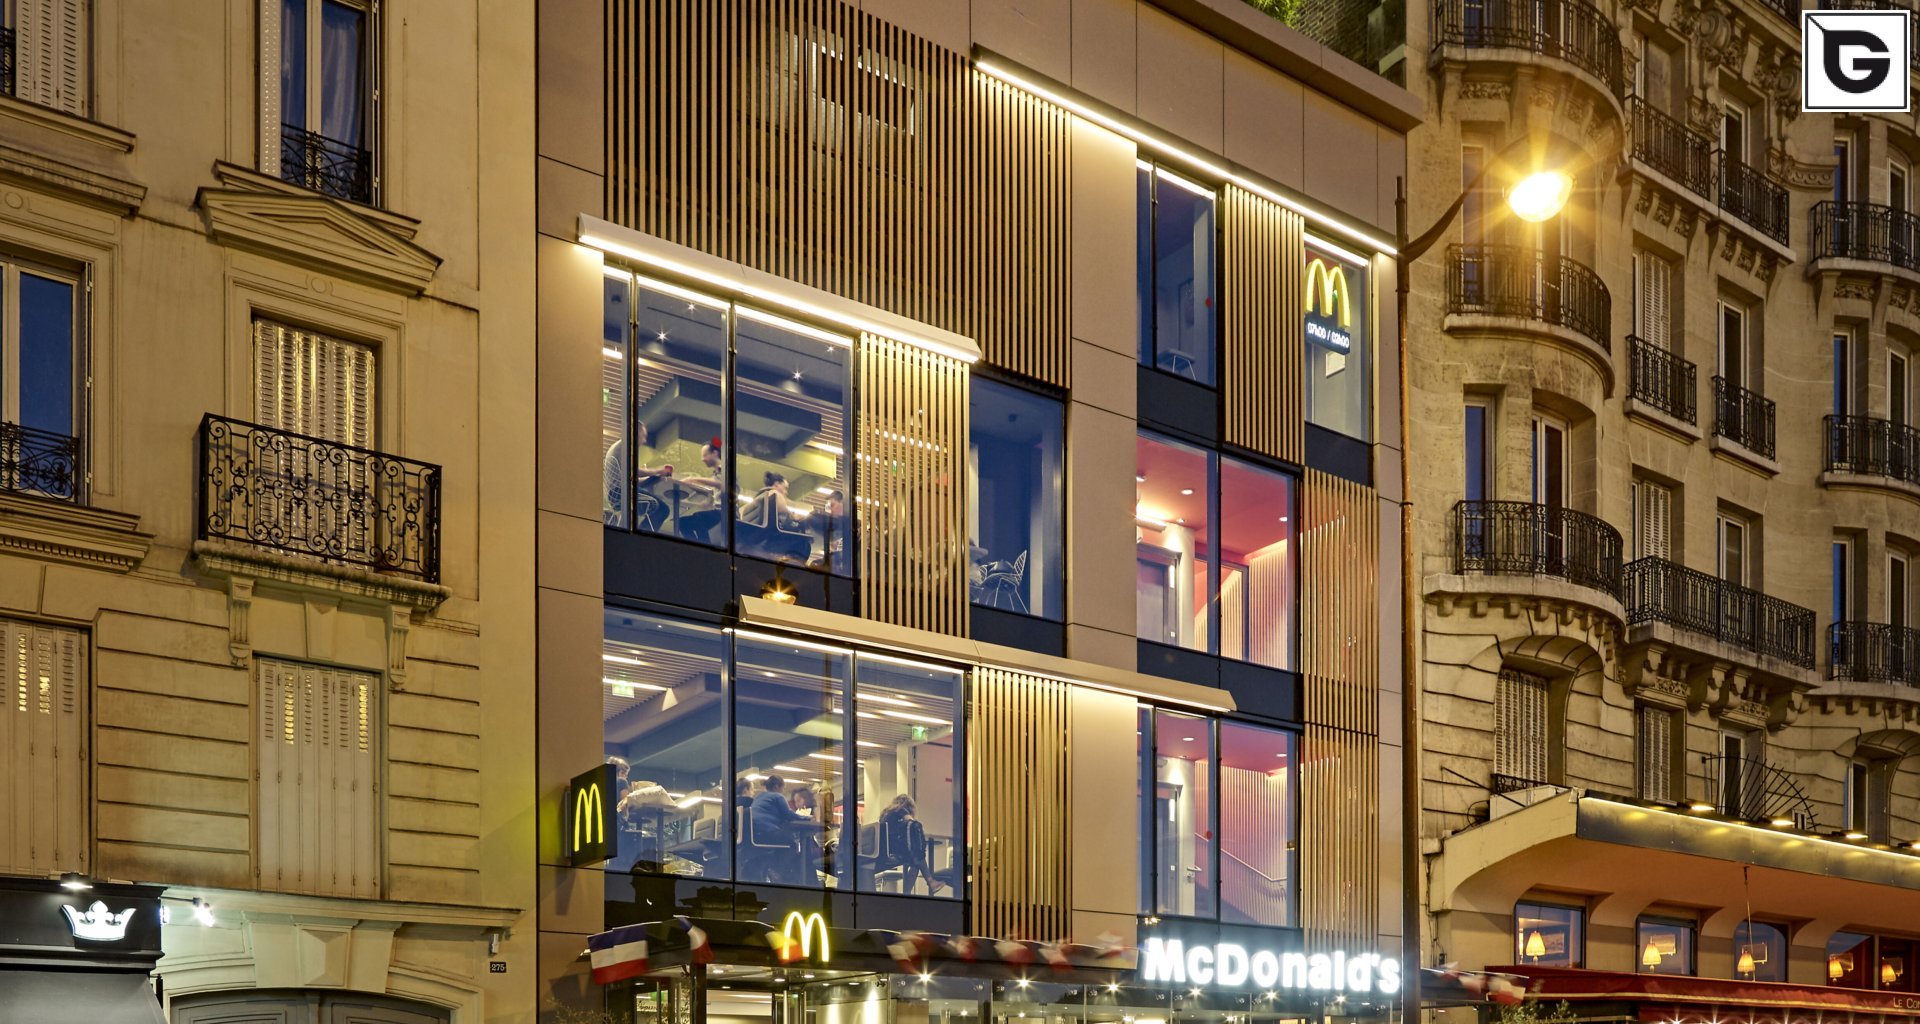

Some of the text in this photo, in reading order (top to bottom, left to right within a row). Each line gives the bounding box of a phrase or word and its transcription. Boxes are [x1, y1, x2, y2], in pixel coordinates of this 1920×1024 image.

[574, 783, 603, 852] M
[782, 911, 830, 963] M
[491, 963, 505, 972] 275
[1143, 936, 1401, 994] McDonald's
